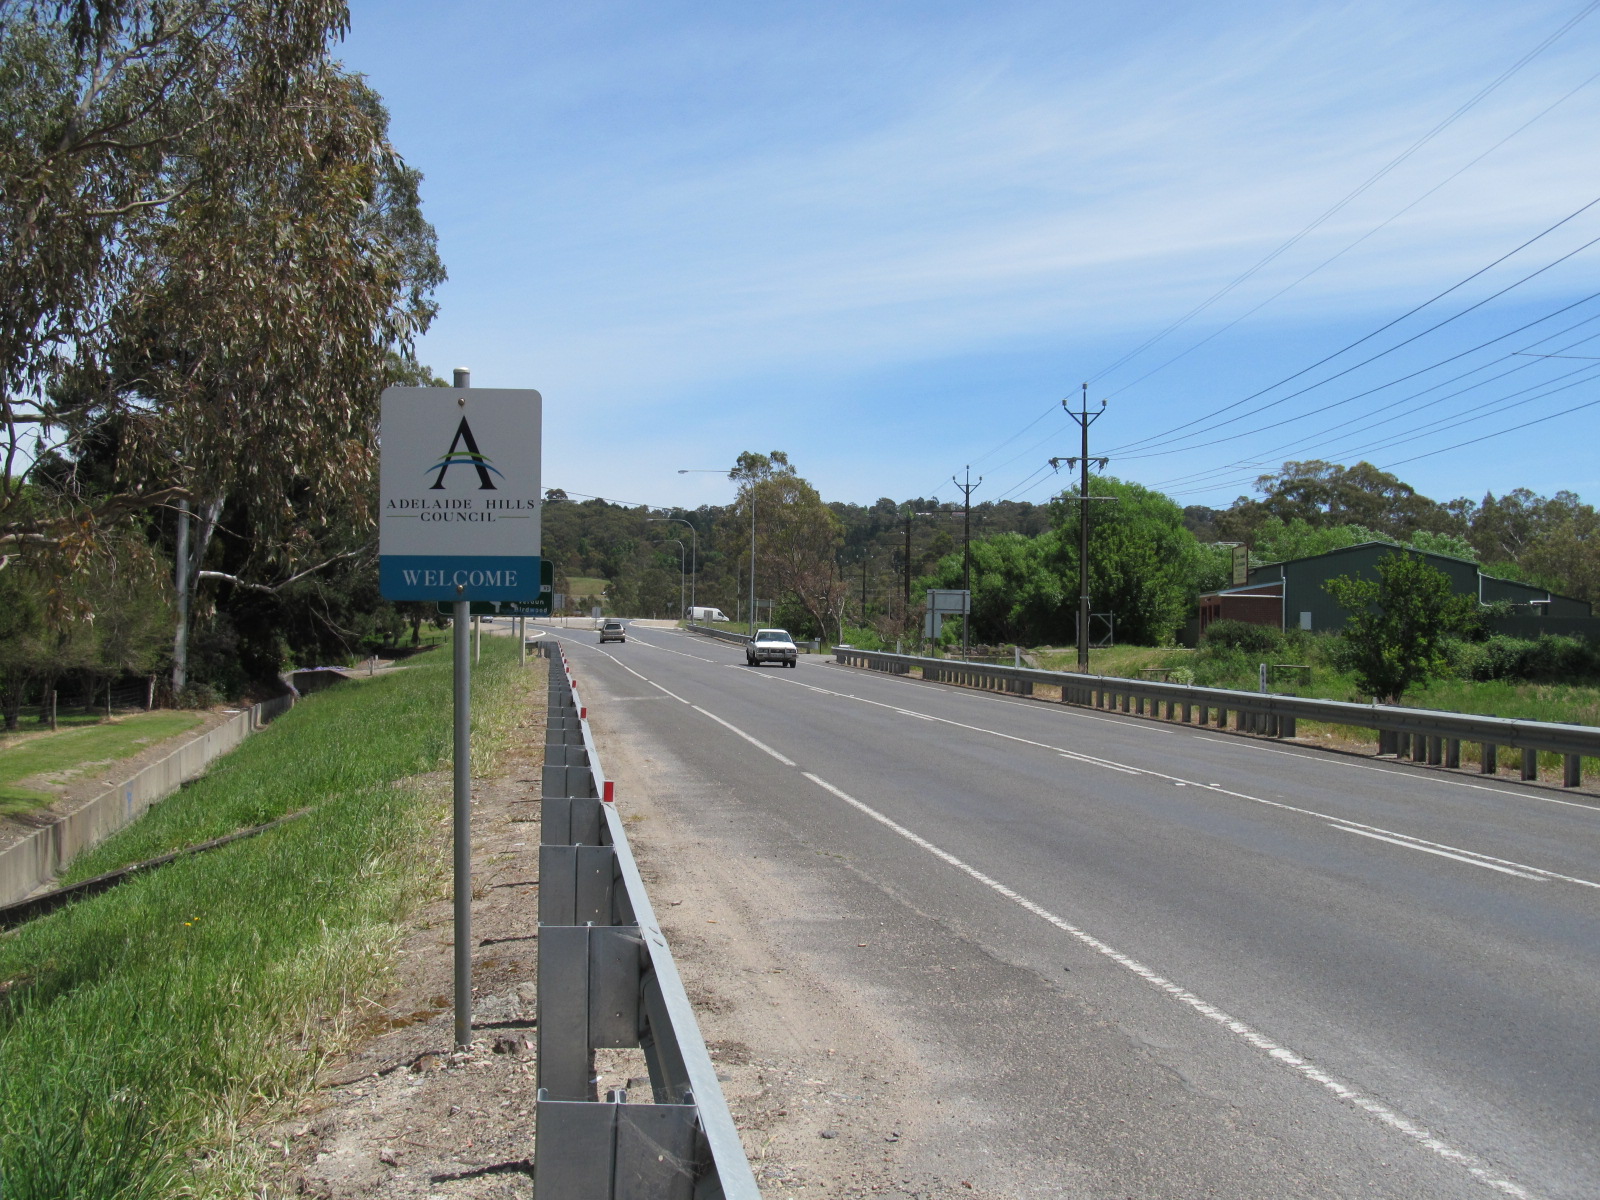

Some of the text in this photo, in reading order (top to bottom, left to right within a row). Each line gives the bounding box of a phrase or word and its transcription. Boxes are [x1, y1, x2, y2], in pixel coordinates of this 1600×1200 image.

[429, 415, 498, 490] A
[386, 499, 535, 510] ADELAIDE HILLS
[420, 511, 496, 522] COUNCIL
[402, 569, 518, 587] WELCOME
